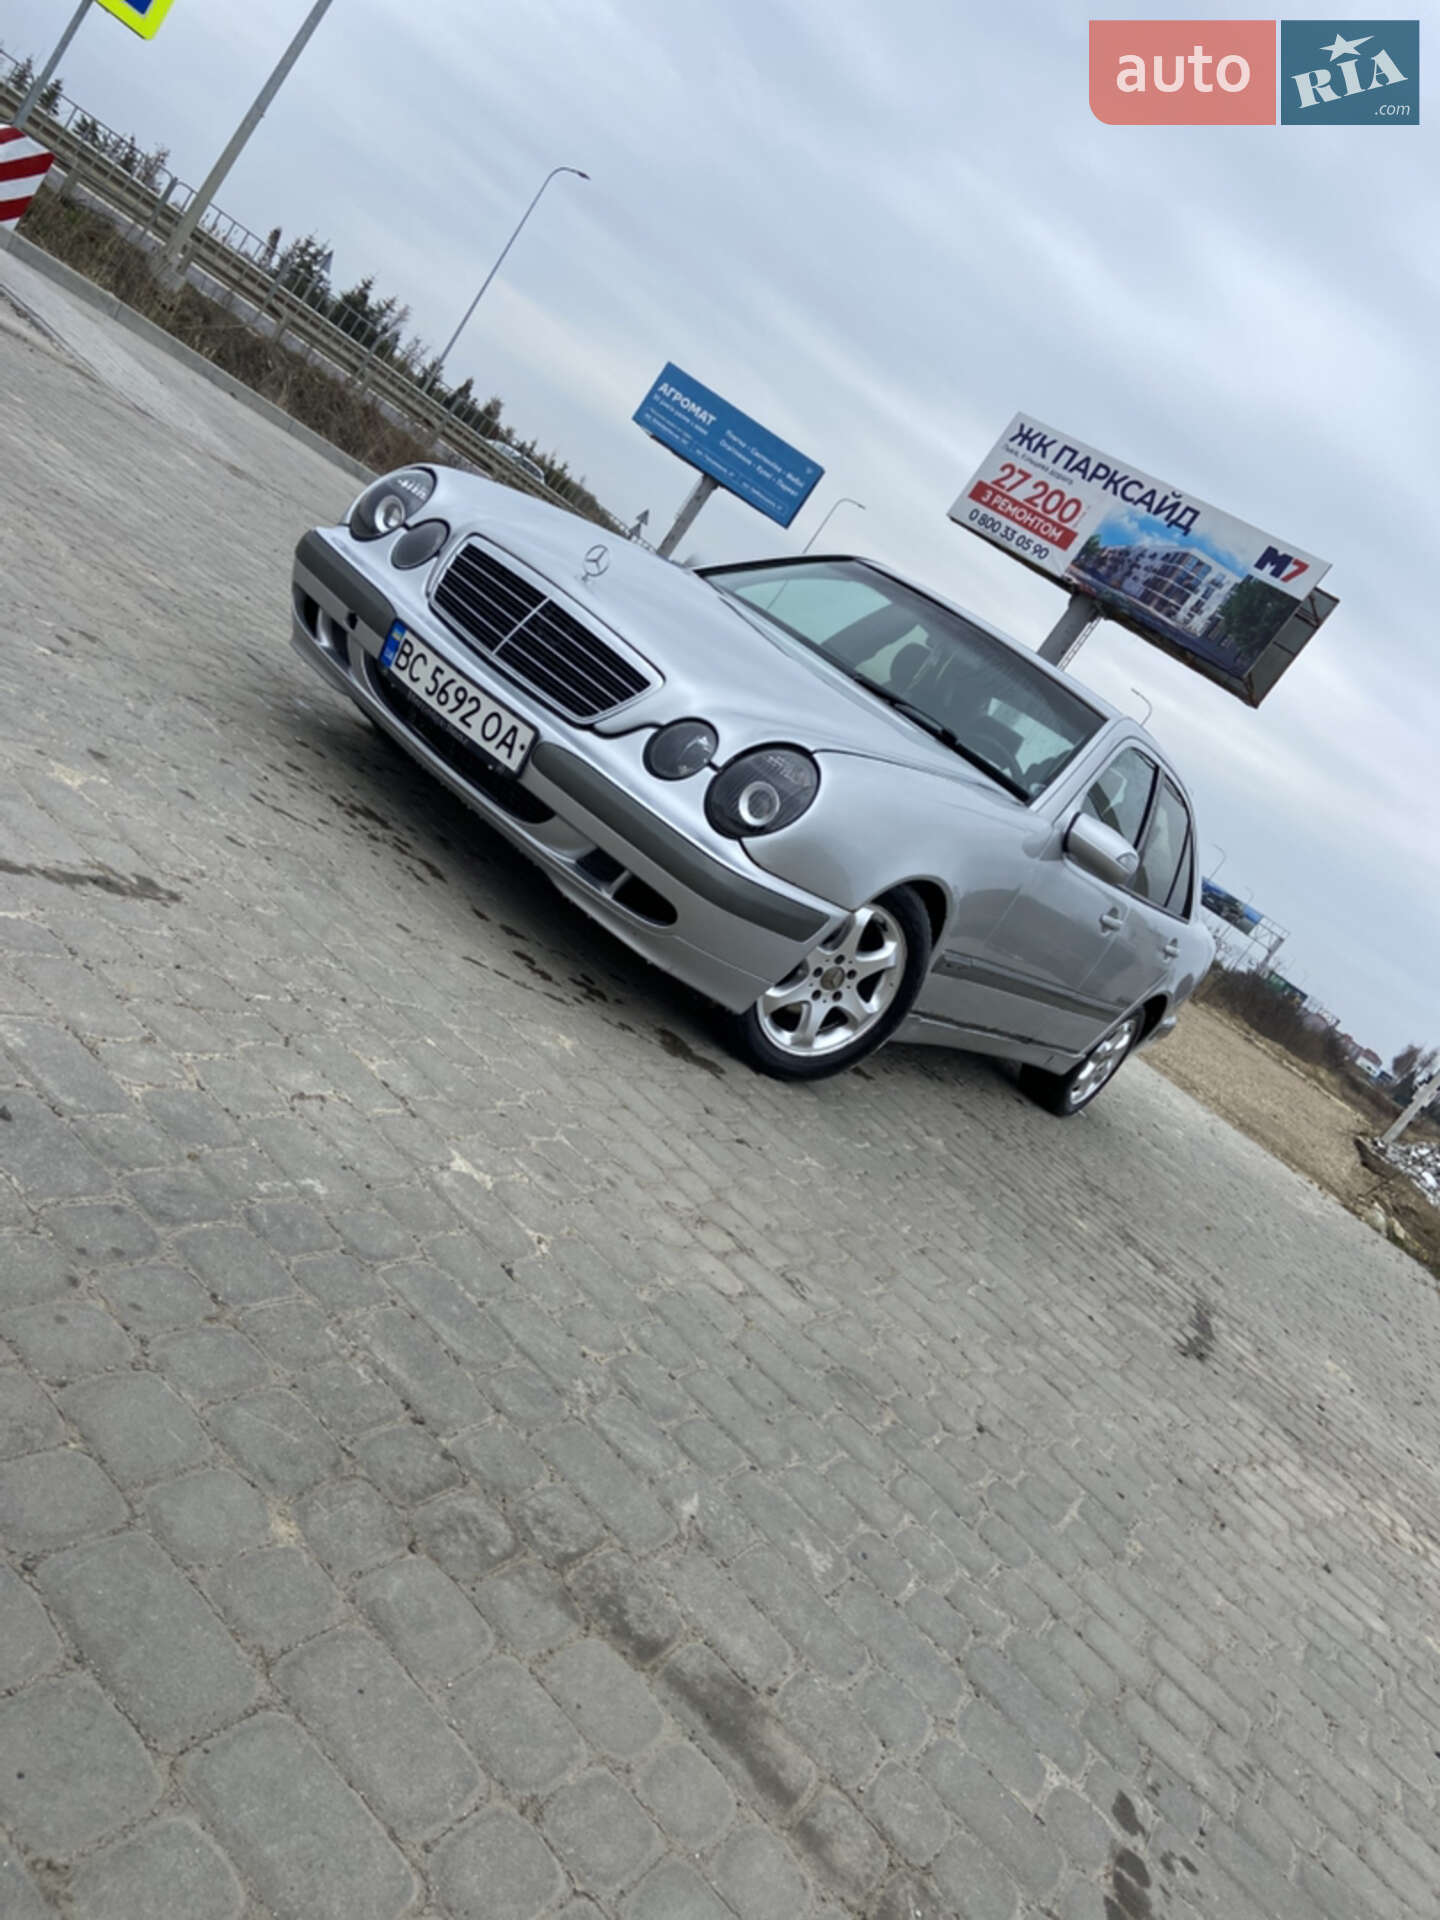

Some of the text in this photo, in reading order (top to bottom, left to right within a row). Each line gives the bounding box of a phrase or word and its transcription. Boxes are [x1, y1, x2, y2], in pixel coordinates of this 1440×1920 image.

[658, 382, 717, 426] АГРОМАТ
[991, 462, 1032, 492] 27
[1023, 481, 1082, 523] 200
[1009, 422, 1057, 459] ЖК
[1052, 444, 1200, 536] ПАРКСАЙД
[968, 508, 1050, 560] 0 800 33 05 90
[991, 494, 1064, 541] РЕМОНТОМ
[1253, 545, 1310, 584] M7
[394, 638, 519, 759] BC 5692 OA
